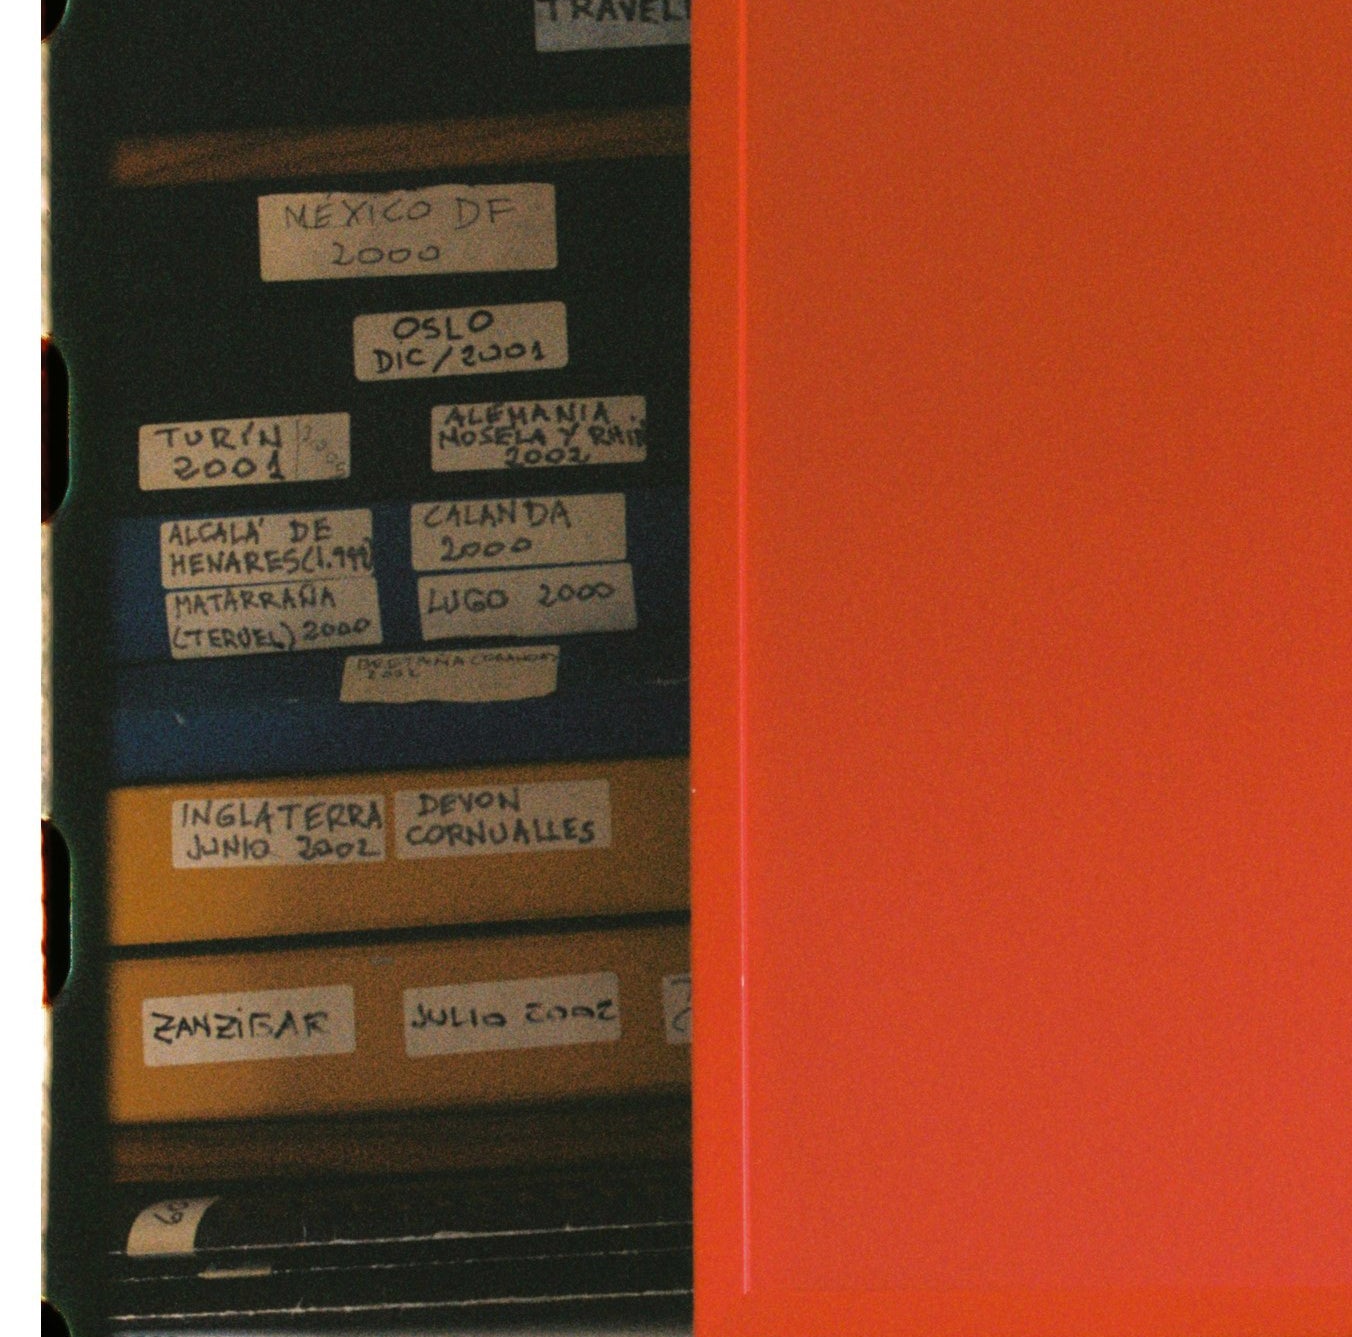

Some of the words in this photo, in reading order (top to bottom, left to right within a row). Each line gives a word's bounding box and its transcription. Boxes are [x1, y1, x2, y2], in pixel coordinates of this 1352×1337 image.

[456, 197, 517, 230] DF
[332, 242, 441, 266] 2000
[392, 310, 494, 340] OSLO
[445, 402, 609, 428] ALEMANIA
[559, 422, 580, 447] Y
[174, 455, 287, 481] 2001
[424, 498, 572, 529] CALANDA
[289, 517, 333, 543] DE
[441, 536, 533, 561] 2000
[427, 586, 509, 616] LUGO
[536, 582, 617, 606] 2000
[301, 617, 371, 642] 2000
[181, 800, 384, 832] INGLATERRA
[416, 787, 521, 817] DEVON
[406, 817, 596, 848] CORNUALLES
[186, 834, 271, 861] JUNIO
[298, 834, 381, 861] 2002
[411, 1002, 507, 1031] JULIO
[526, 999, 621, 1025] 2002
